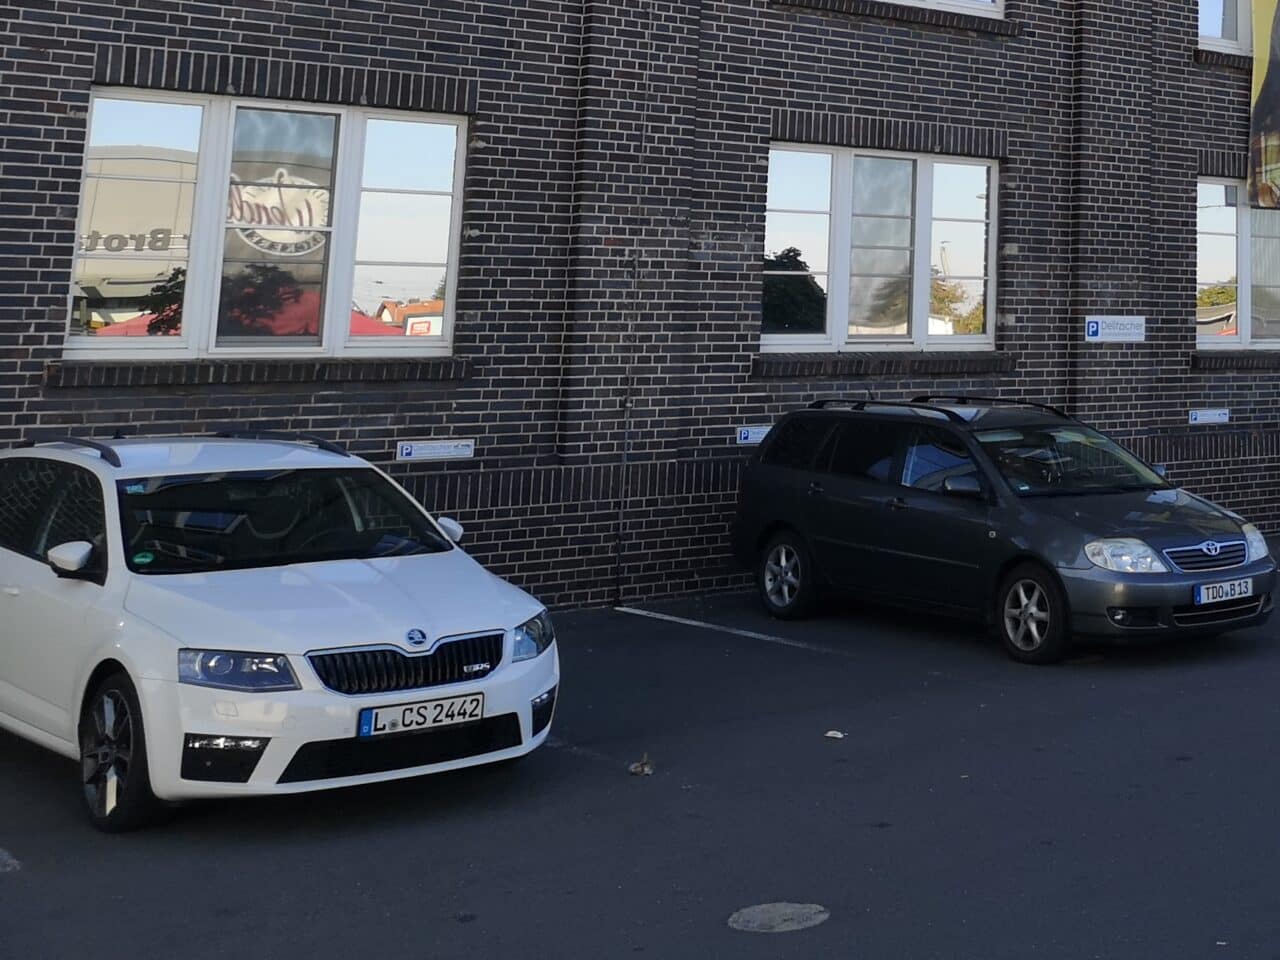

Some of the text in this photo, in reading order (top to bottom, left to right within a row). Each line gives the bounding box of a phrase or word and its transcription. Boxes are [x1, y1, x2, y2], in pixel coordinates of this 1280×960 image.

[1237, 581, 1249, 596] 13
[373, 698, 480, 732] L CS 2442
